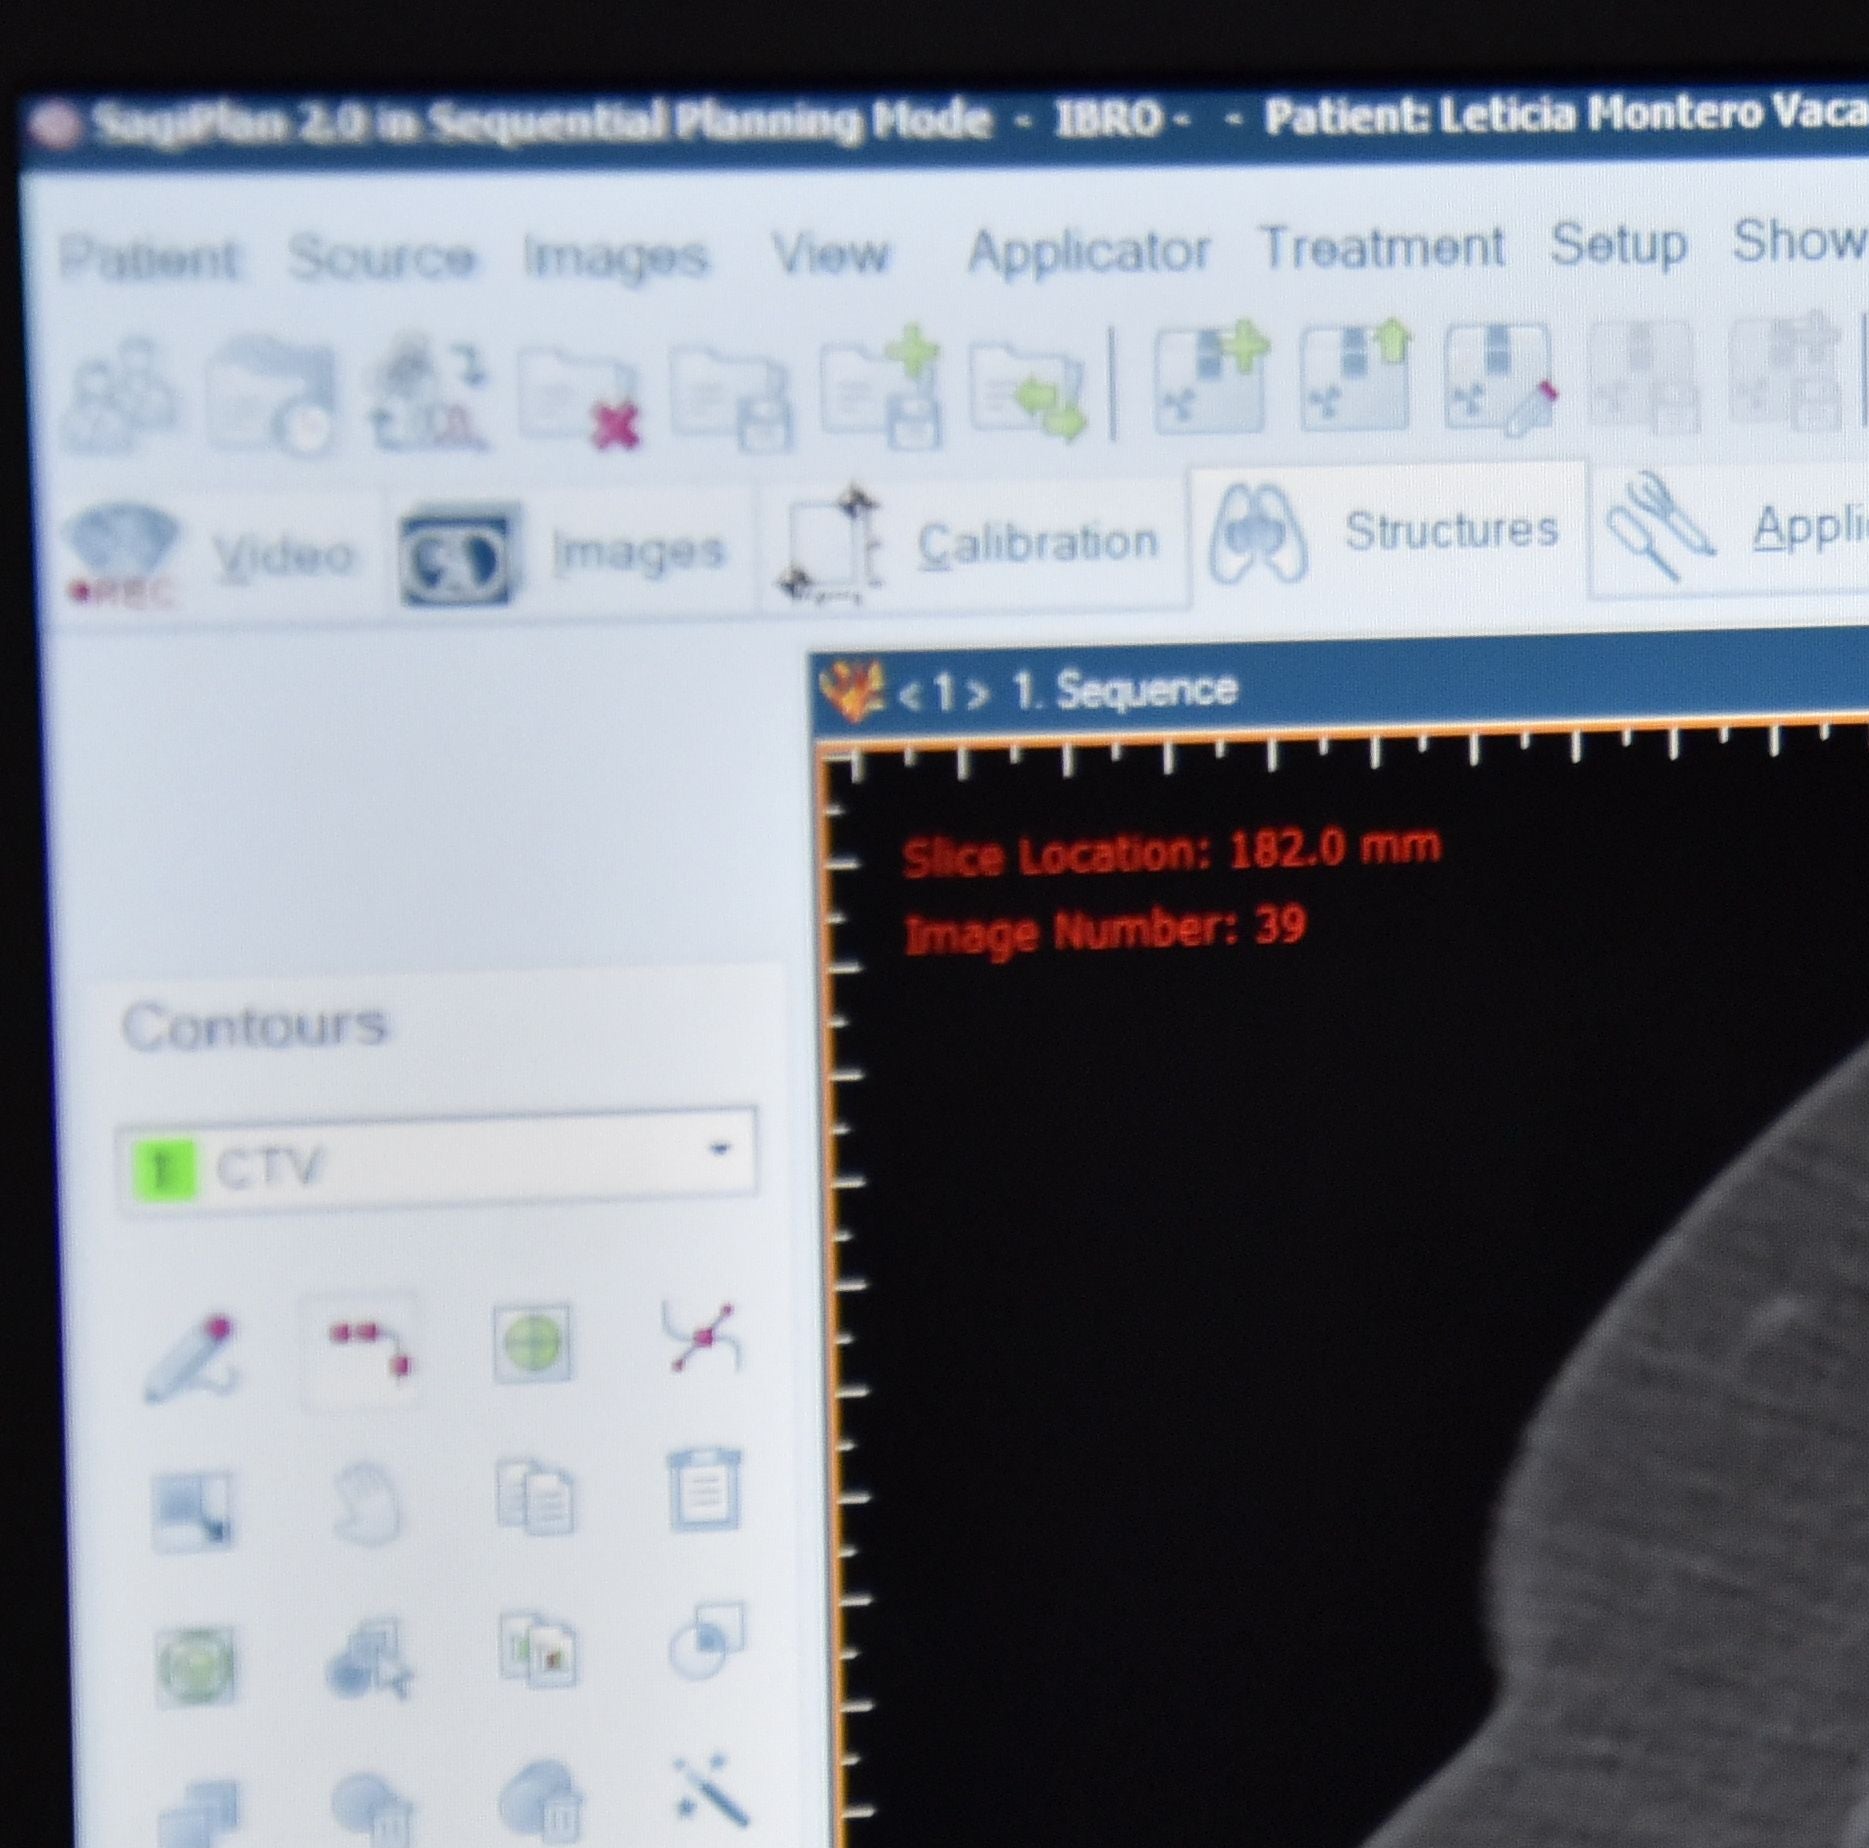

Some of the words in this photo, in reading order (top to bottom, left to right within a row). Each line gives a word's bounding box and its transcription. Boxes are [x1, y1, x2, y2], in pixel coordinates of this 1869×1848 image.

[94, 97, 290, 153] SagiPlan
[300, 100, 367, 147] 2.0
[377, 98, 422, 145] in
[430, 97, 667, 150] Sequential
[674, 96, 866, 149] Planning
[871, 95, 993, 142] Mode
[1055, 97, 1165, 139] IBRO
[1264, 94, 1431, 137] Patient:
[1440, 93, 1576, 134] Leticia
[1587, 90, 1764, 131] Montero
[58, 233, 240, 281] Patient
[286, 231, 477, 281] Source
[524, 233, 710, 289] Images
[771, 229, 892, 275] View
[967, 227, 1211, 284] Applicator
[1258, 223, 1506, 270] Treatment
[1550, 220, 1689, 275] Setup
[1732, 217, 1869, 263] Show
[214, 533, 357, 577] Video
[553, 528, 727, 582] Images
[919, 522, 1158, 564] Calibration
[1345, 509, 1562, 556] Structures
[1013, 669, 1045, 711] 1.
[1057, 666, 1240, 715] Sequence
[904, 832, 1004, 879] Slice
[1019, 831, 1211, 877] Location:
[1231, 825, 1347, 870] 182.0
[1360, 828, 1444, 865] mm
[904, 911, 1040, 965] Image
[1053, 902, 1239, 951] Number:
[1254, 902, 1309, 946] 39
[121, 999, 393, 1053] Contours
[216, 1147, 327, 1191] CTV
